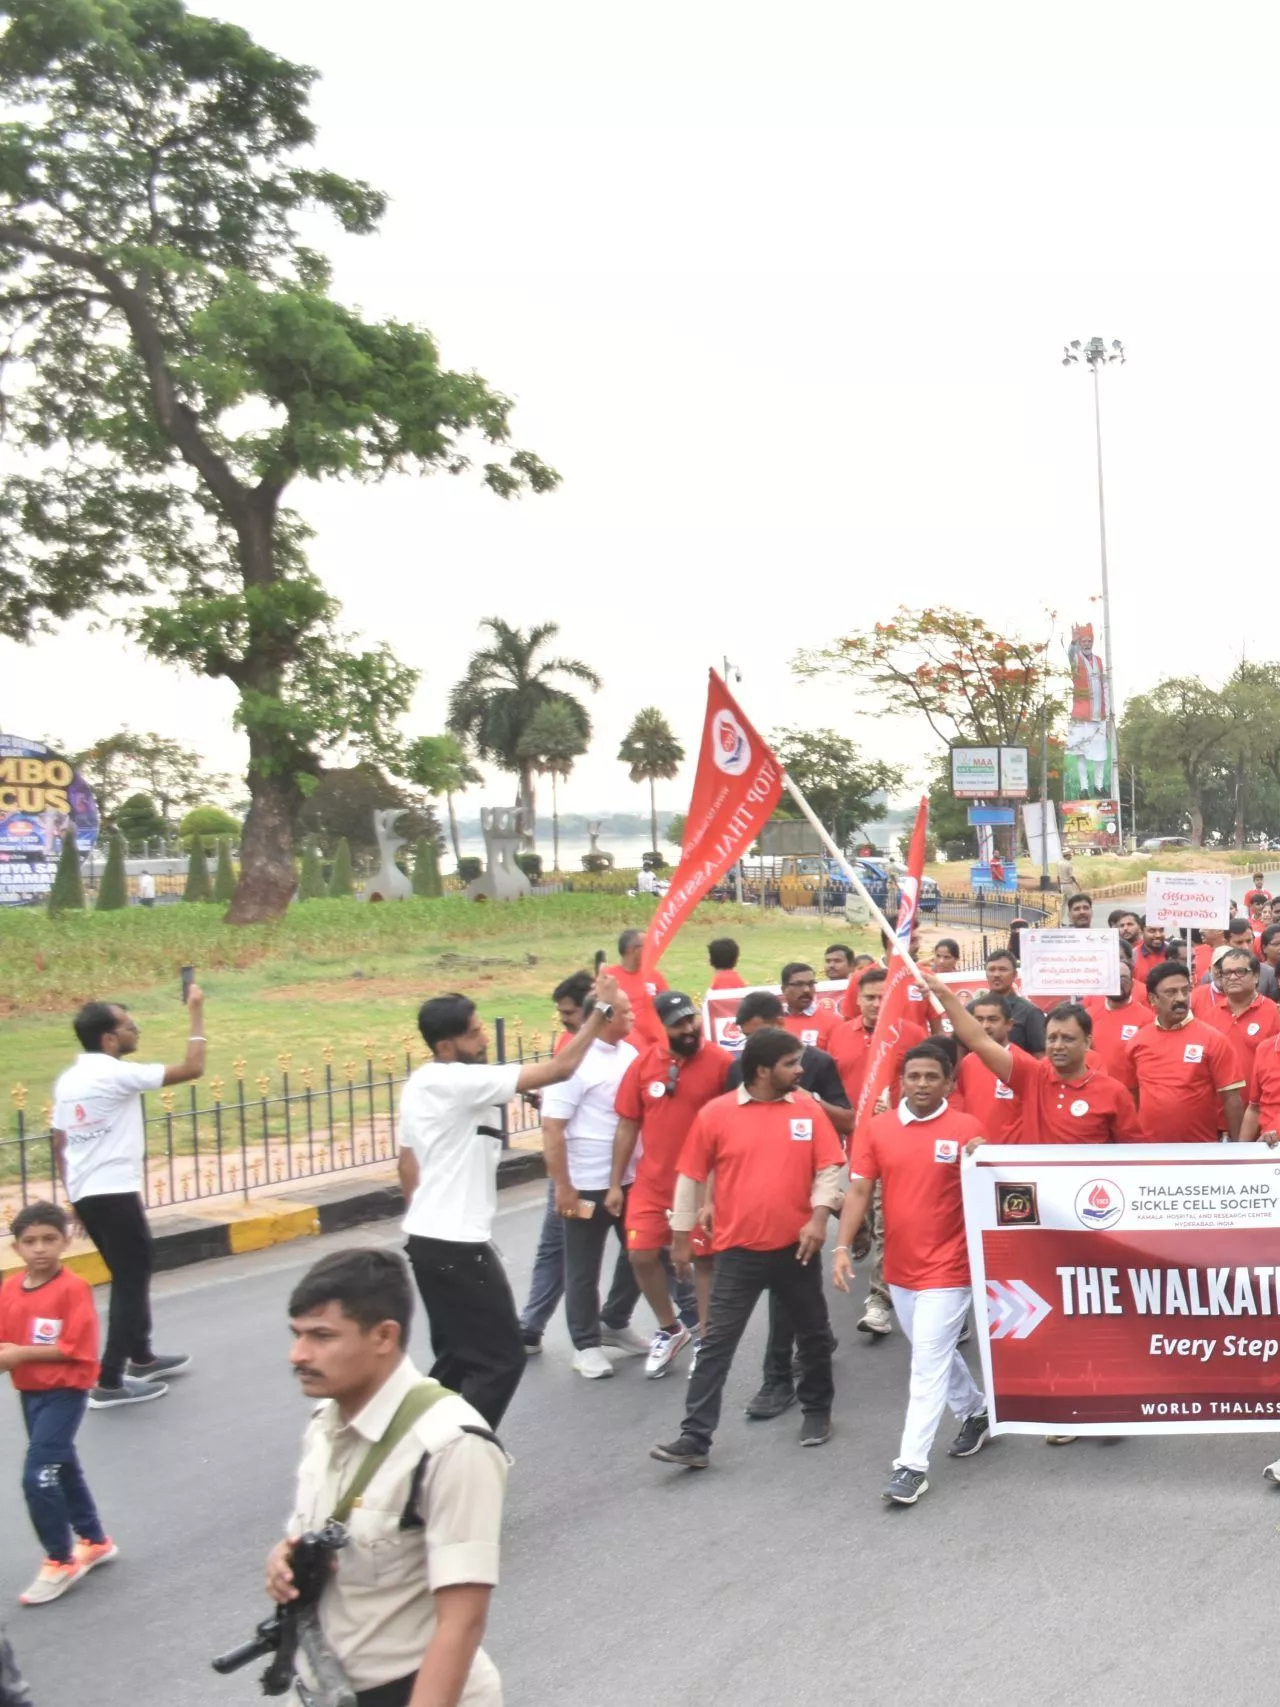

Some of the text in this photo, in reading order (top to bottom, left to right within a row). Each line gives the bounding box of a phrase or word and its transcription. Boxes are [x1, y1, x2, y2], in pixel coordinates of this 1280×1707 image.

[973, 758, 993, 766] MAA
[1139, 1184, 1270, 1197] THALASSEMIA AND
[1131, 1198, 1278, 1211] SICKLE CELL SOCIETY
[1056, 1267, 1123, 1315] THE
[1150, 1334, 1216, 1362] Every
[1223, 1335, 1279, 1362] Step
[1141, 1402, 1202, 1415] WORLD
